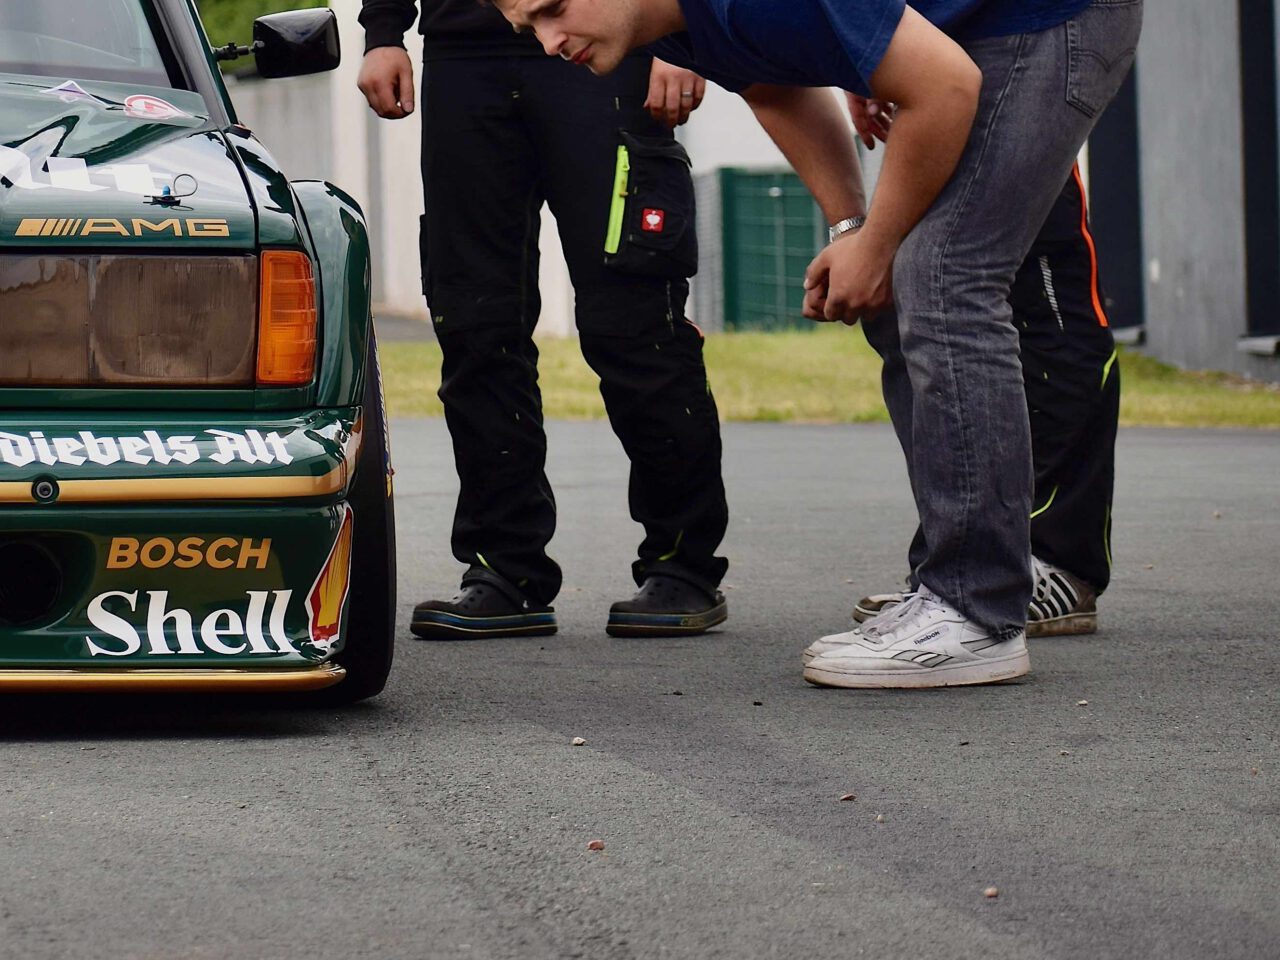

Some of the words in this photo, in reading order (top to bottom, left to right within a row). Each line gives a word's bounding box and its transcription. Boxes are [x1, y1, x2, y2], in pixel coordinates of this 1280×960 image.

[81, 218, 230, 237] AMG
[204, 428, 295, 466] Alt
[106, 536, 273, 569] BOSCH
[85, 588, 300, 657] Shell
